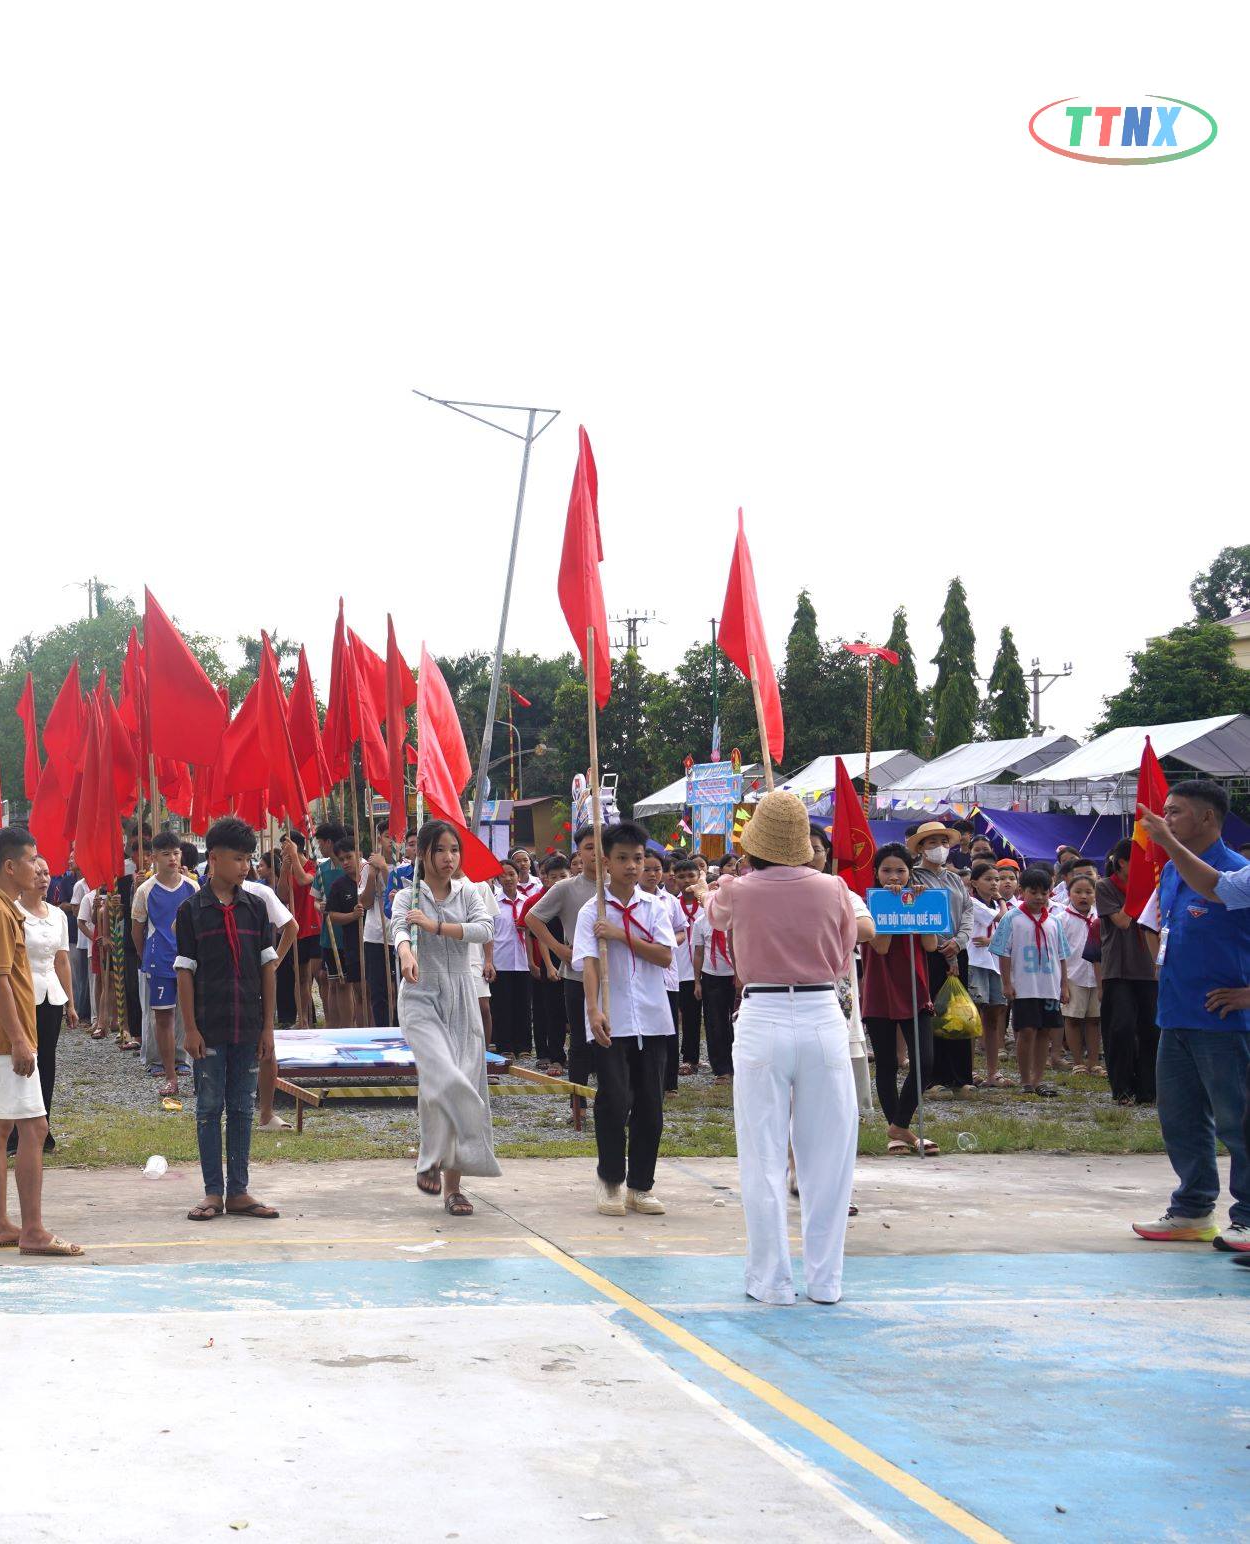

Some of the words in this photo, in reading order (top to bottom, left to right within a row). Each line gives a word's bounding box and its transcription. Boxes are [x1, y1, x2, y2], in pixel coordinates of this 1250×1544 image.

[877, 913, 887, 926] CHI
[888, 911, 899, 928] ĐỘI
[900, 911, 916, 925] THÔN
[157, 986, 164, 999] 7
